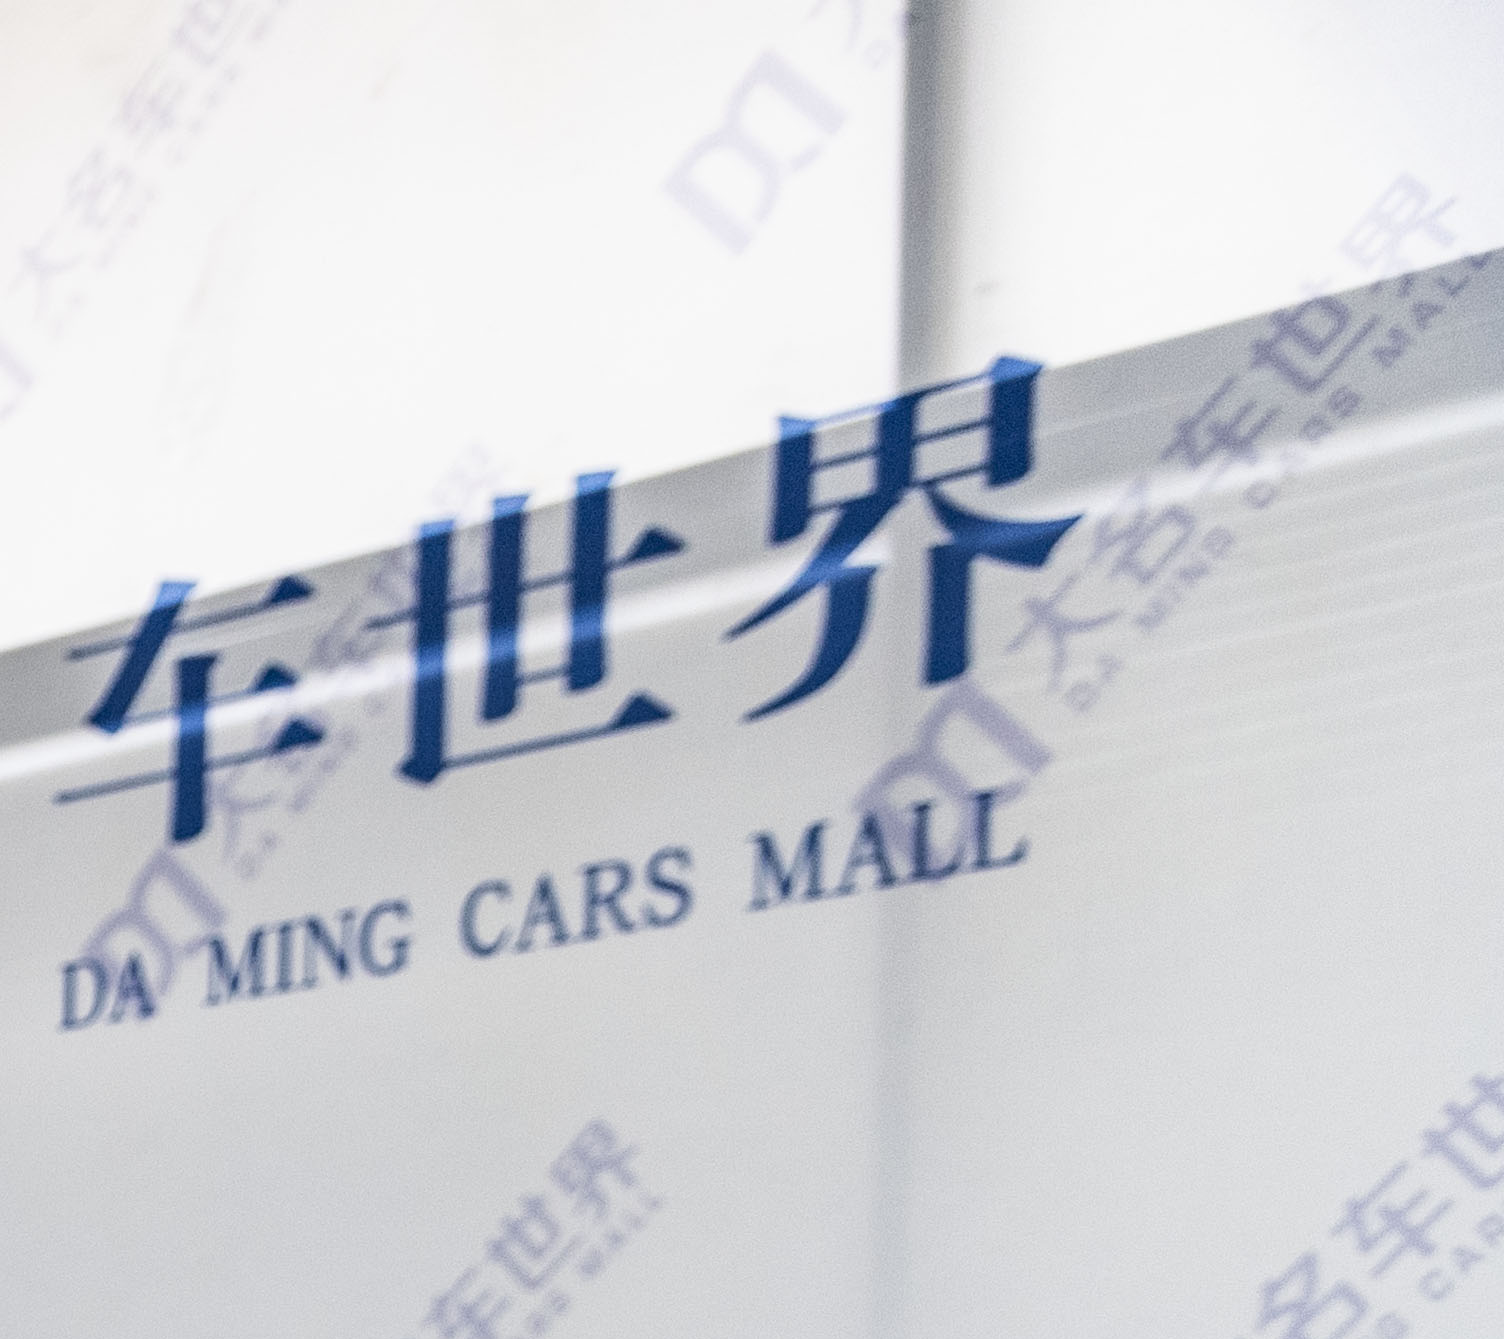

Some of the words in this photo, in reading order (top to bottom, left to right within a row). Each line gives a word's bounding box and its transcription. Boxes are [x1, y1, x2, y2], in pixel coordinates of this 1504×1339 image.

[52, 353, 1083, 845] 车世界
[58, 948, 156, 1032] DA
[203, 899, 415, 1006] MING
[458, 847, 694, 960] CARS
[744, 788, 1031, 912] MALL
[577, 1194, 668, 1280] MALL
